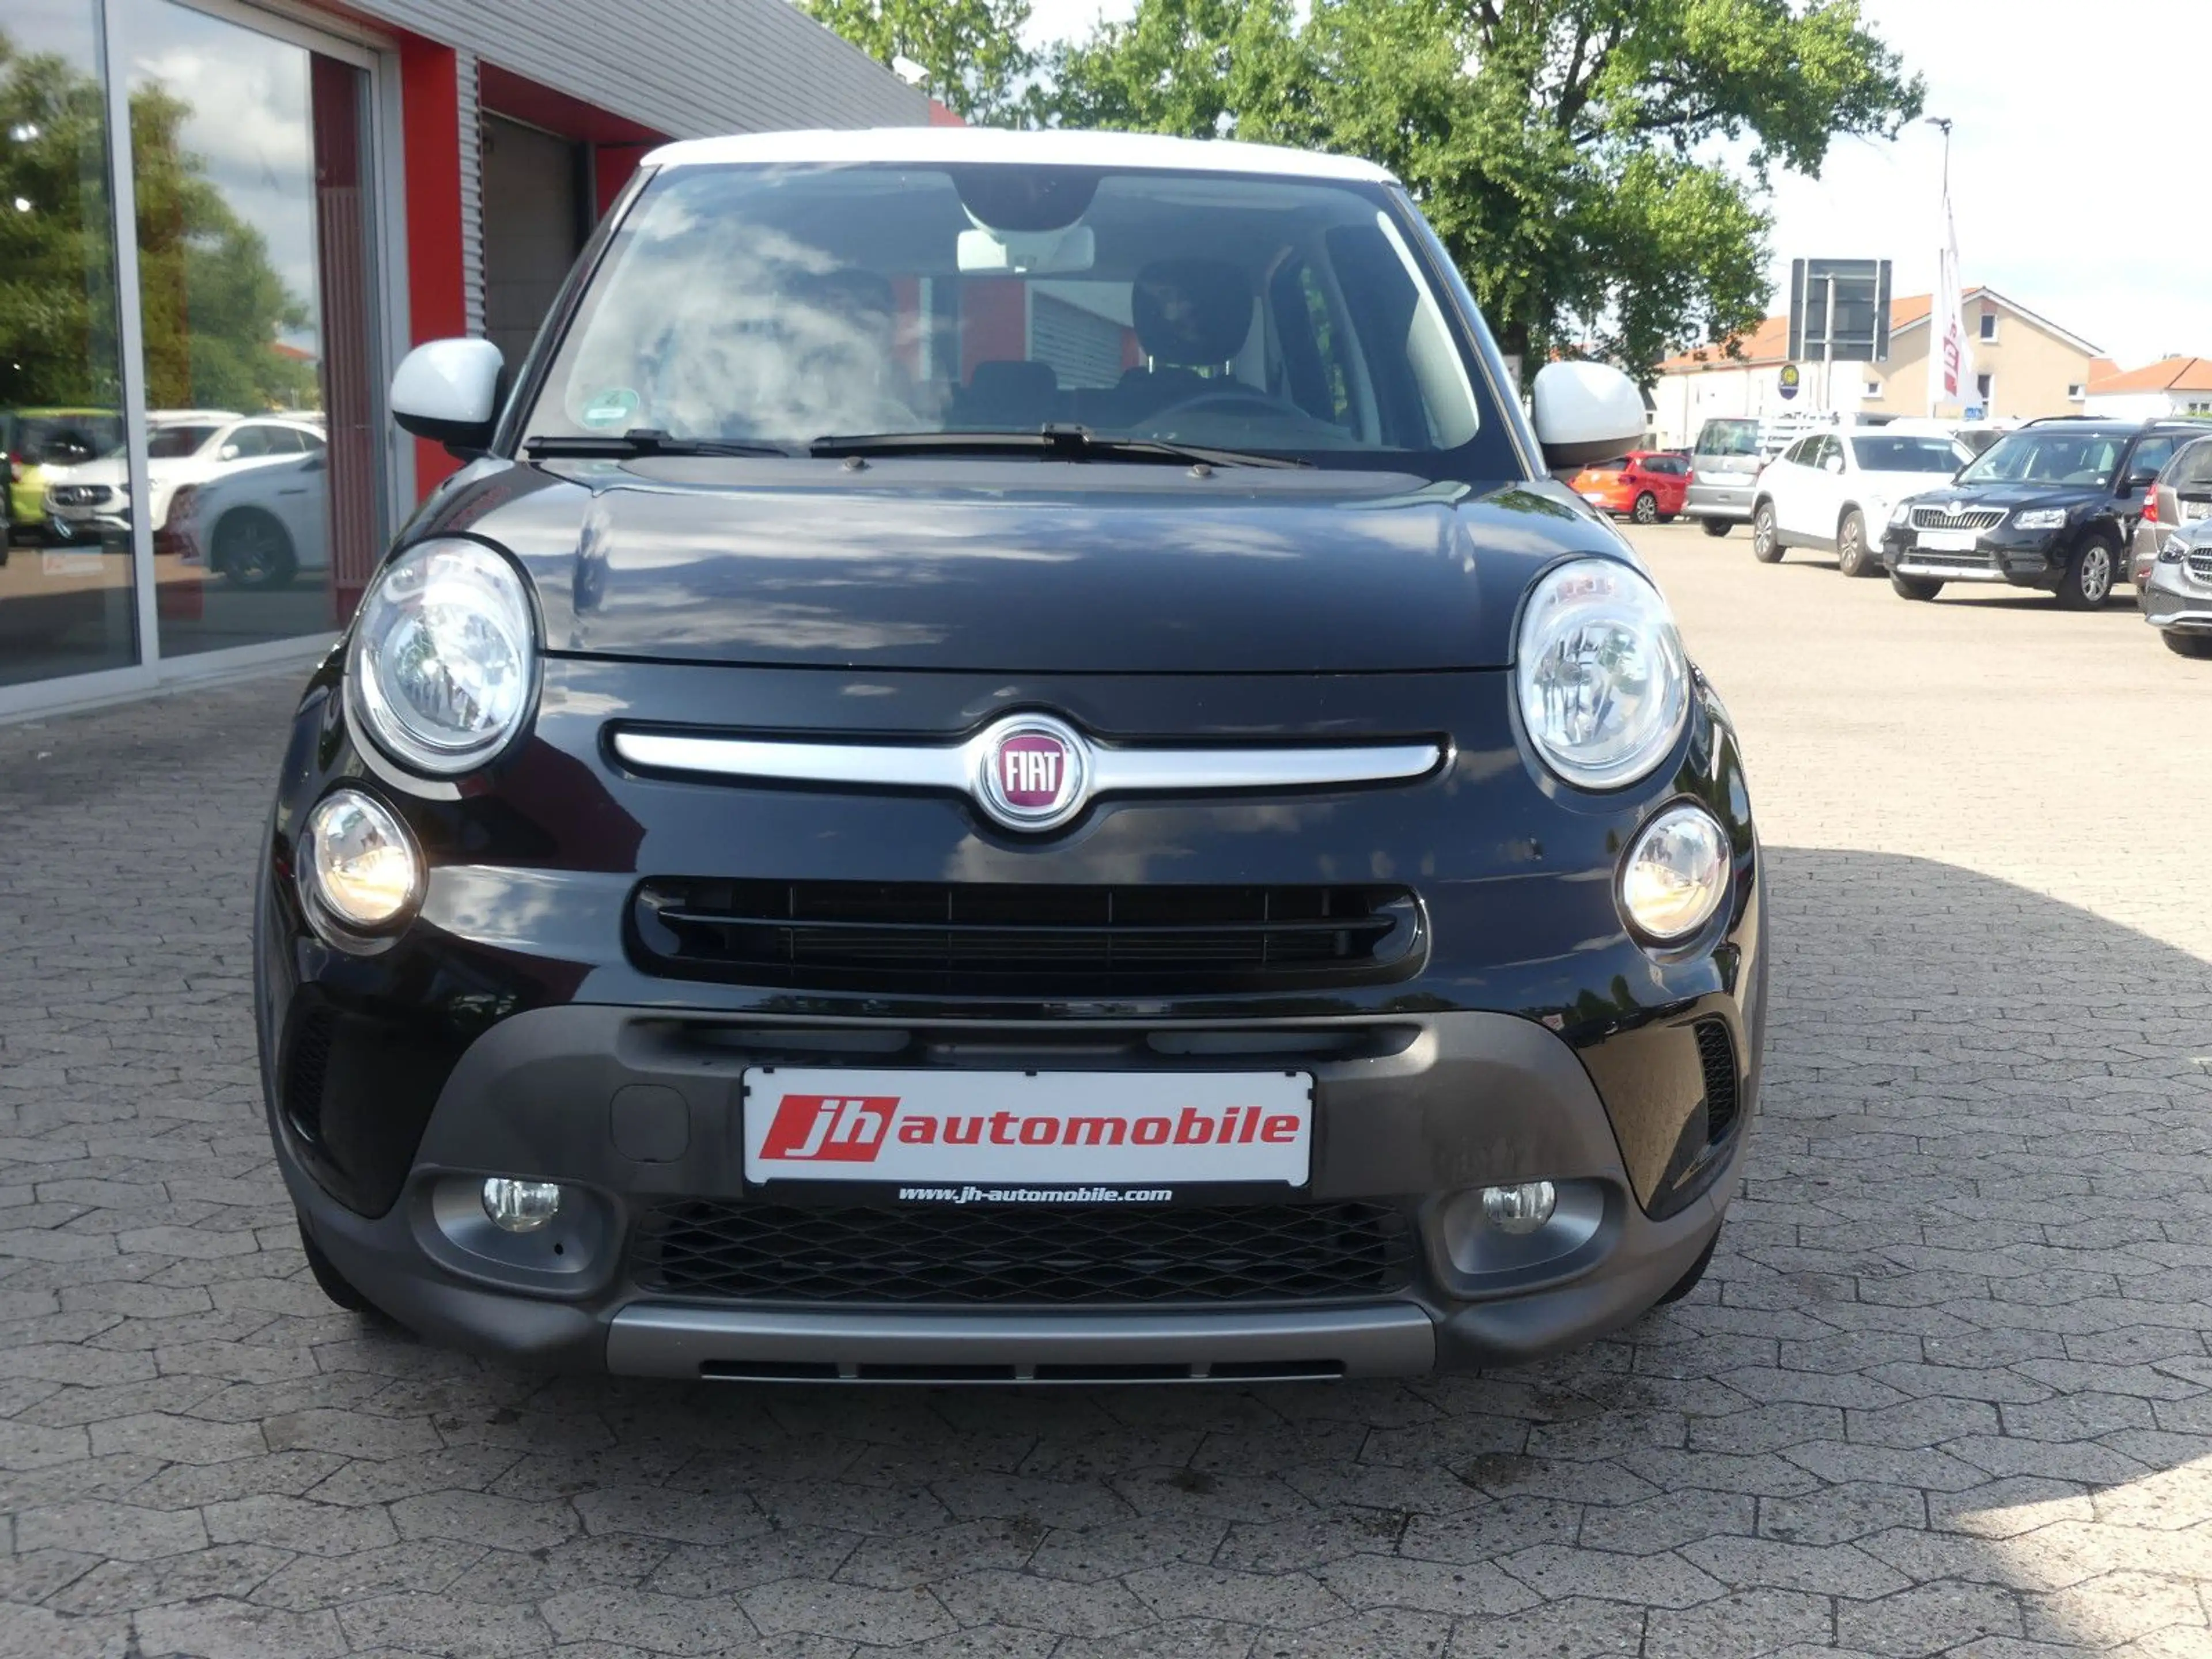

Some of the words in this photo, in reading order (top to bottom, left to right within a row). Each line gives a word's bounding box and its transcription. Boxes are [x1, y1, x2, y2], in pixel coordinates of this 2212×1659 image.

[1005, 751, 1060, 791] FIAT
[898, 1106, 1300, 1145] automobile
[899, 1185, 1172, 1203] www.jh-automobile.com
